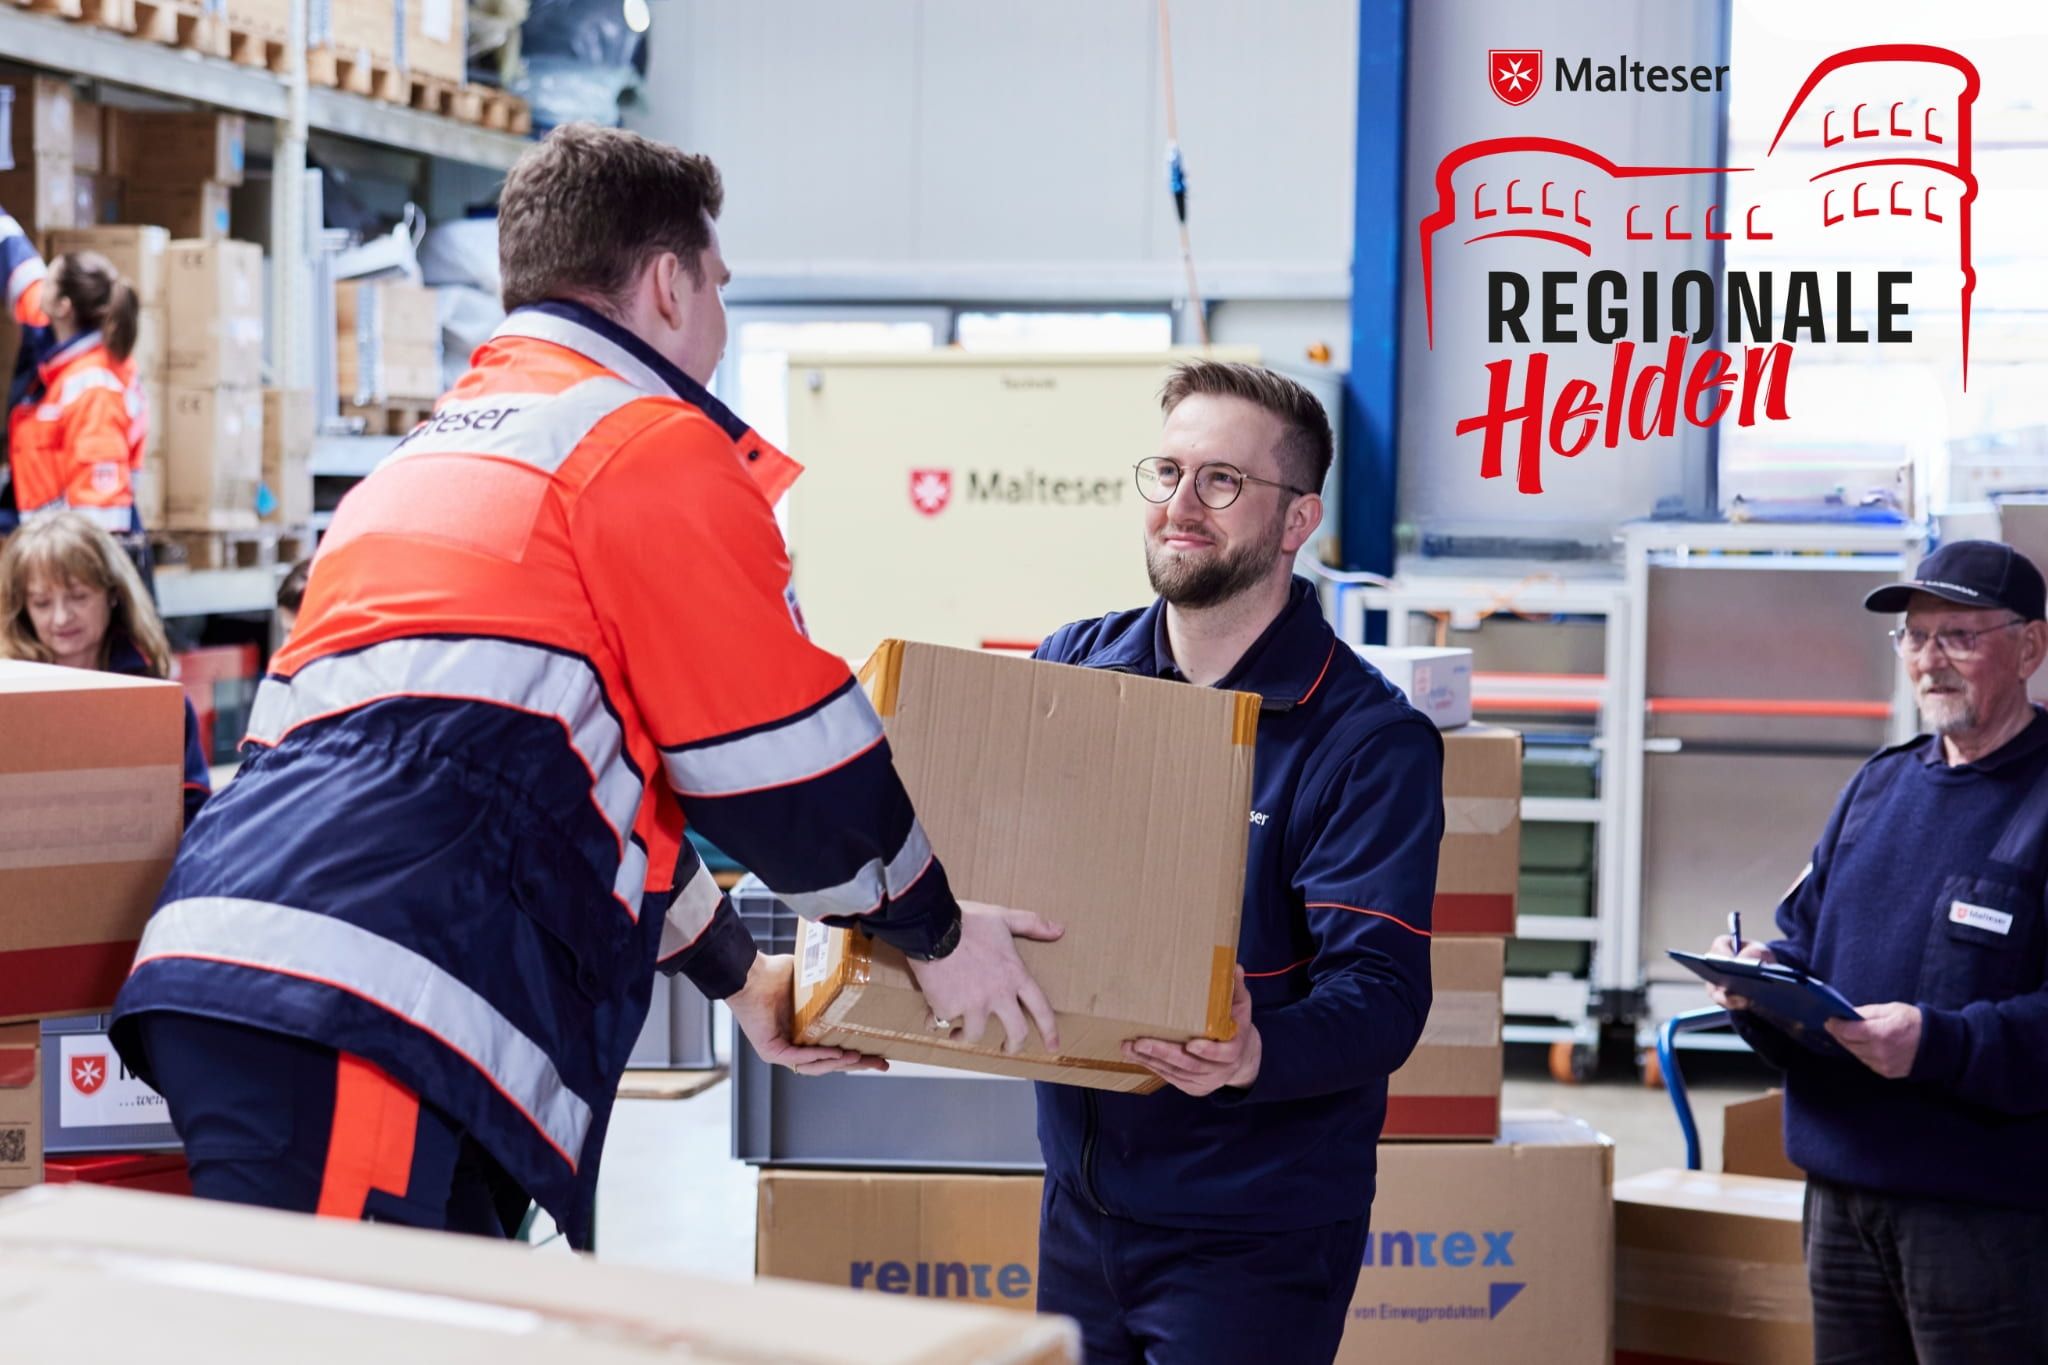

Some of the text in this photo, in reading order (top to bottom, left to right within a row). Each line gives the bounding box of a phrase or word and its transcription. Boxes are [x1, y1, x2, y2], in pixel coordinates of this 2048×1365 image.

[394, 407, 520, 450] teser
[967, 468, 1123, 504] Malteser
[1362, 1230, 1515, 1267] intex
[850, 1260, 1032, 1298] reinte
[1355, 1306, 1376, 1319] von
[1379, 1303, 1488, 1323] Einwegprodukten
